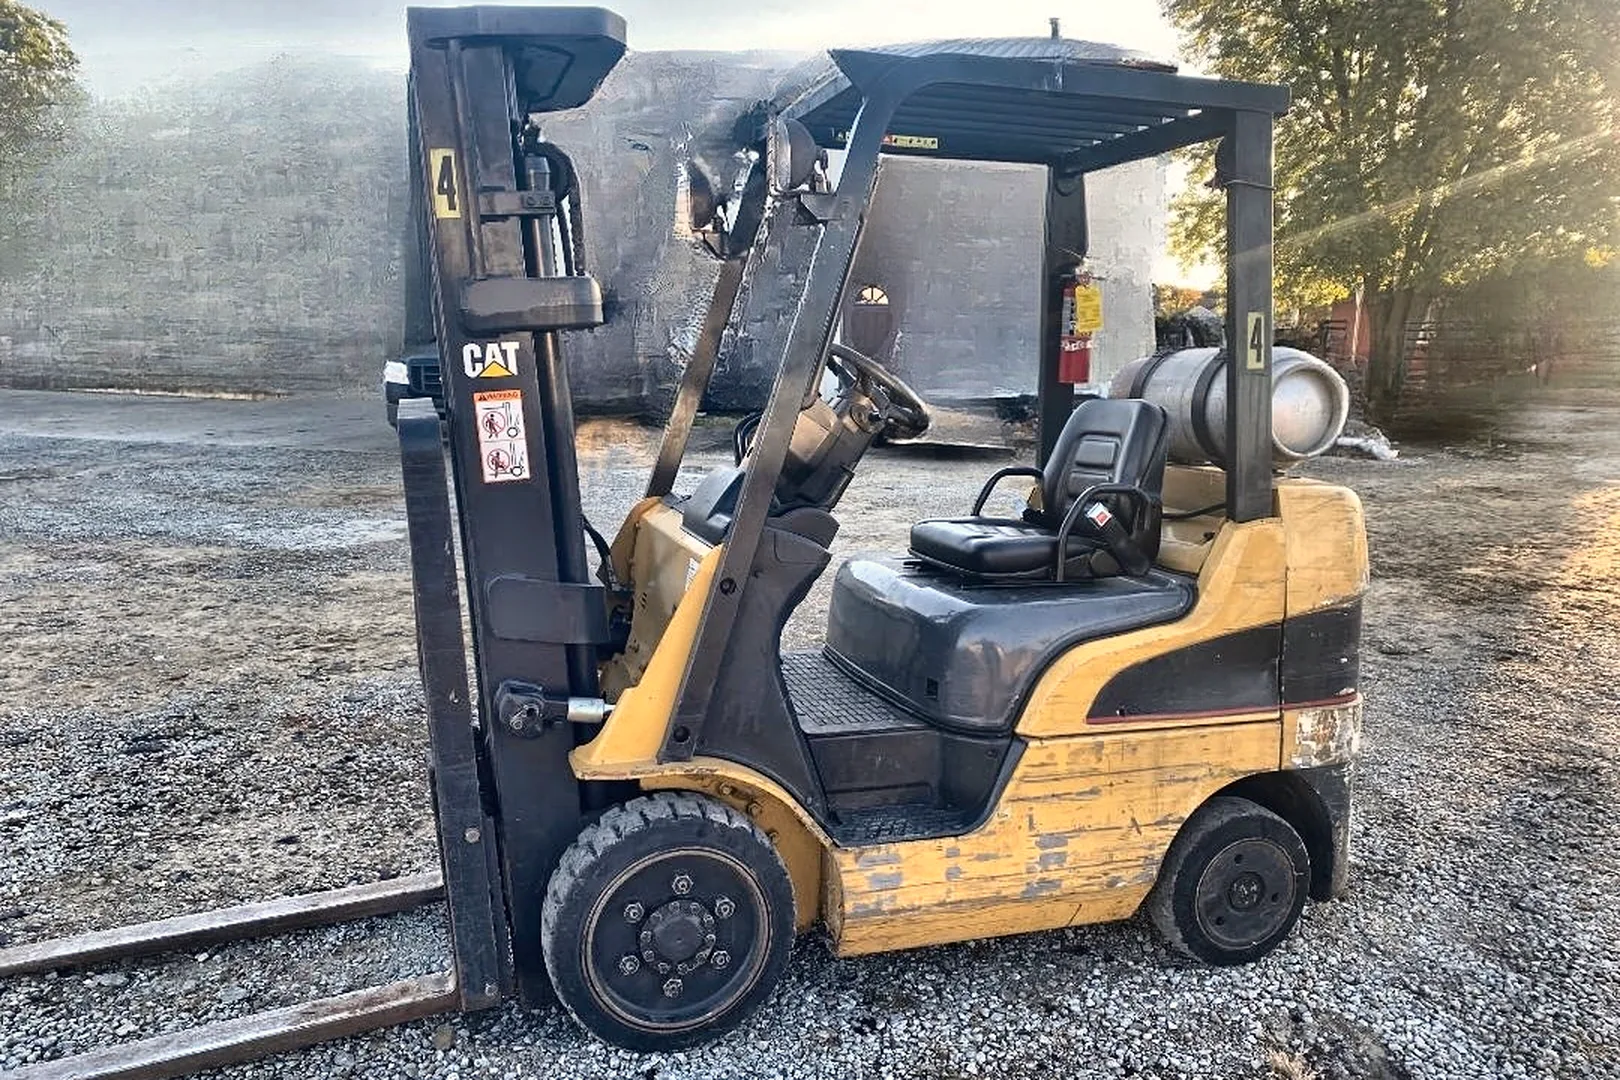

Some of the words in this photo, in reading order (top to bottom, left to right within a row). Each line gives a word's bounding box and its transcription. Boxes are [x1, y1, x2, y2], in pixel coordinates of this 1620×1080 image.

[438, 155, 456, 210] 4
[462, 341, 520, 379] CAT
[1250, 317, 1262, 362] 4
